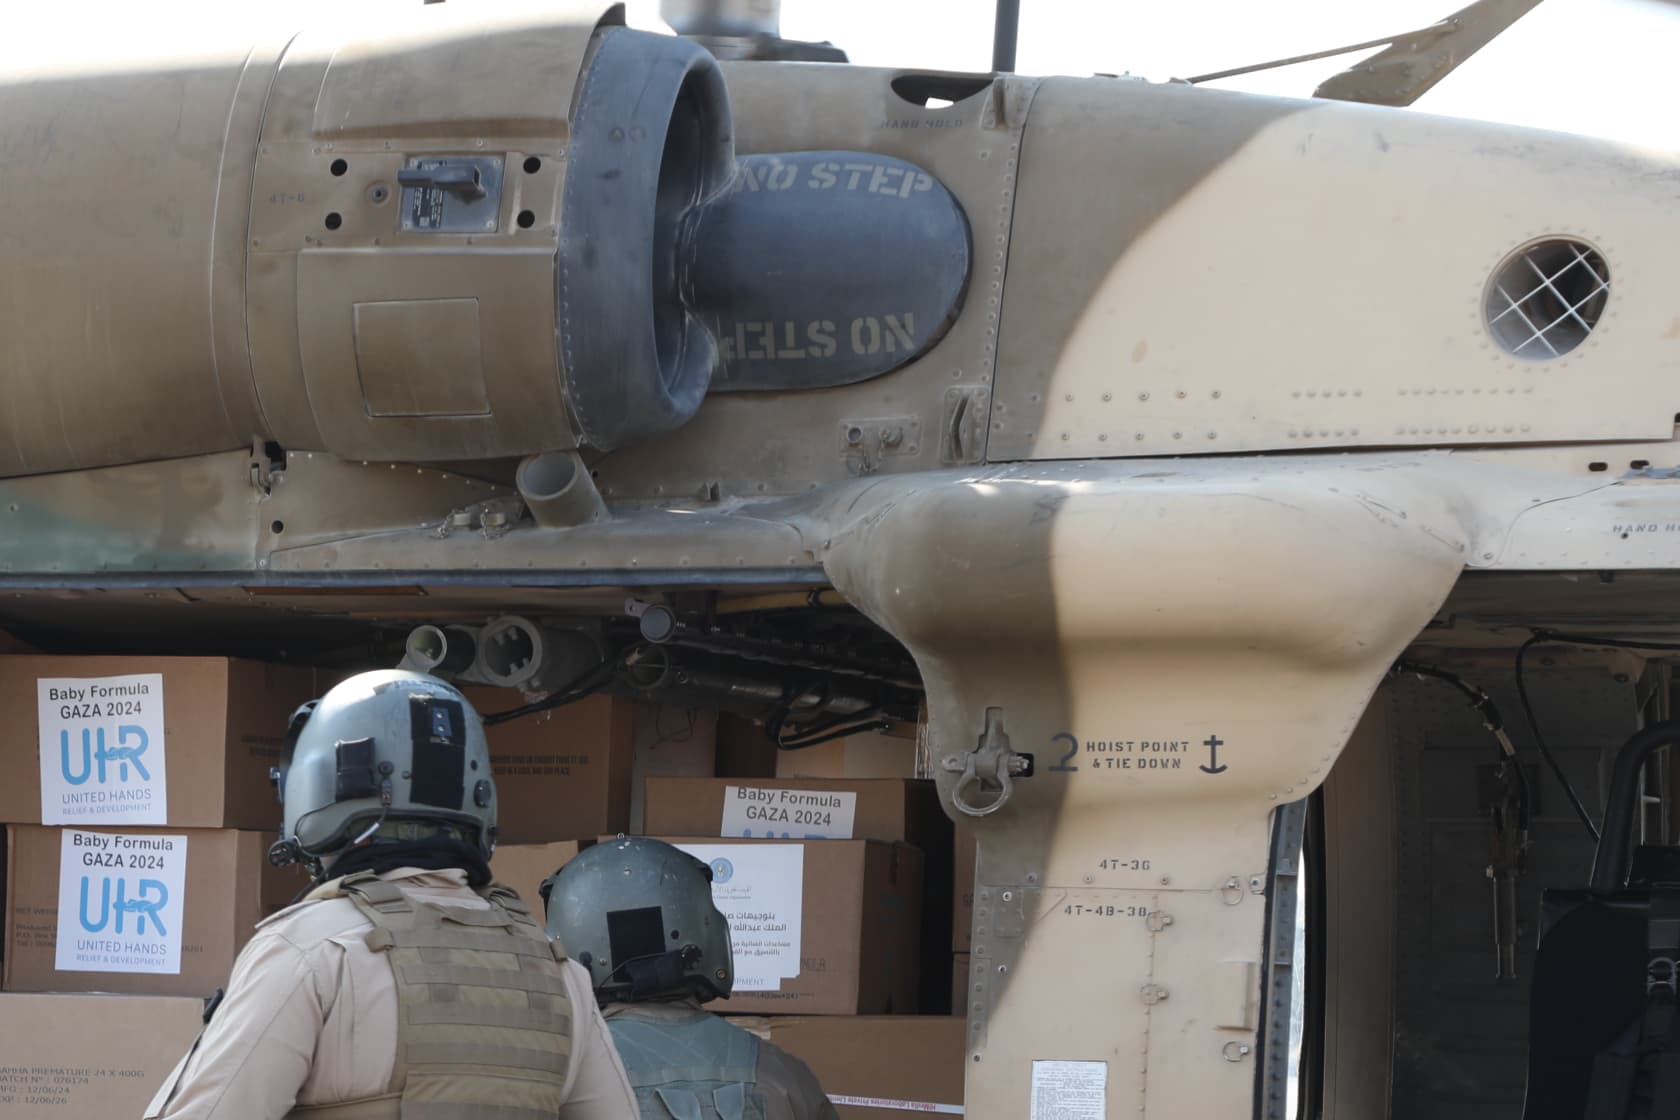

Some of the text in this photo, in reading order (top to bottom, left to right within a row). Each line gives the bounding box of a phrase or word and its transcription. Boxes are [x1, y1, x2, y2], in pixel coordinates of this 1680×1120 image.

[735, 161, 933, 200] NO STEP
[722, 311, 915, 360] NO STEP
[1612, 523, 1658, 532] HAND
[48, 682, 150, 702] Baby Formula
[59, 700, 142, 719] GAZA 2024
[1086, 741, 1190, 753] HOIST POINT
[1092, 757, 1182, 769] & TIE DOWN
[61, 788, 152, 805] UNITED HANDS
[737, 786, 842, 808] Baby Formula
[62, 807, 88, 816] RELIEF
[96, 803, 152, 814] DEVELOPMENT
[746, 806, 832, 827] GAZA 2024
[73, 833, 174, 851] Baby Formula
[82, 851, 165, 870] GAZA 2024
[1098, 859, 1151, 871] 4T-36
[76, 939, 122, 953] UNITED
[124, 942, 168, 956] HANDS
[76, 953, 101, 962] RELIEF
[109, 955, 167, 967] DEVELOPMENT
[31, 1067, 91, 1077] PREMATURE
[93, 1069, 106, 1078] 24
[118, 1070, 145, 1078] 400G
[53, 1076, 89, 1085] 076174
[27, 1086, 70, 1095] 12/06/24
[24, 1096, 68, 1105] 12/06/26
